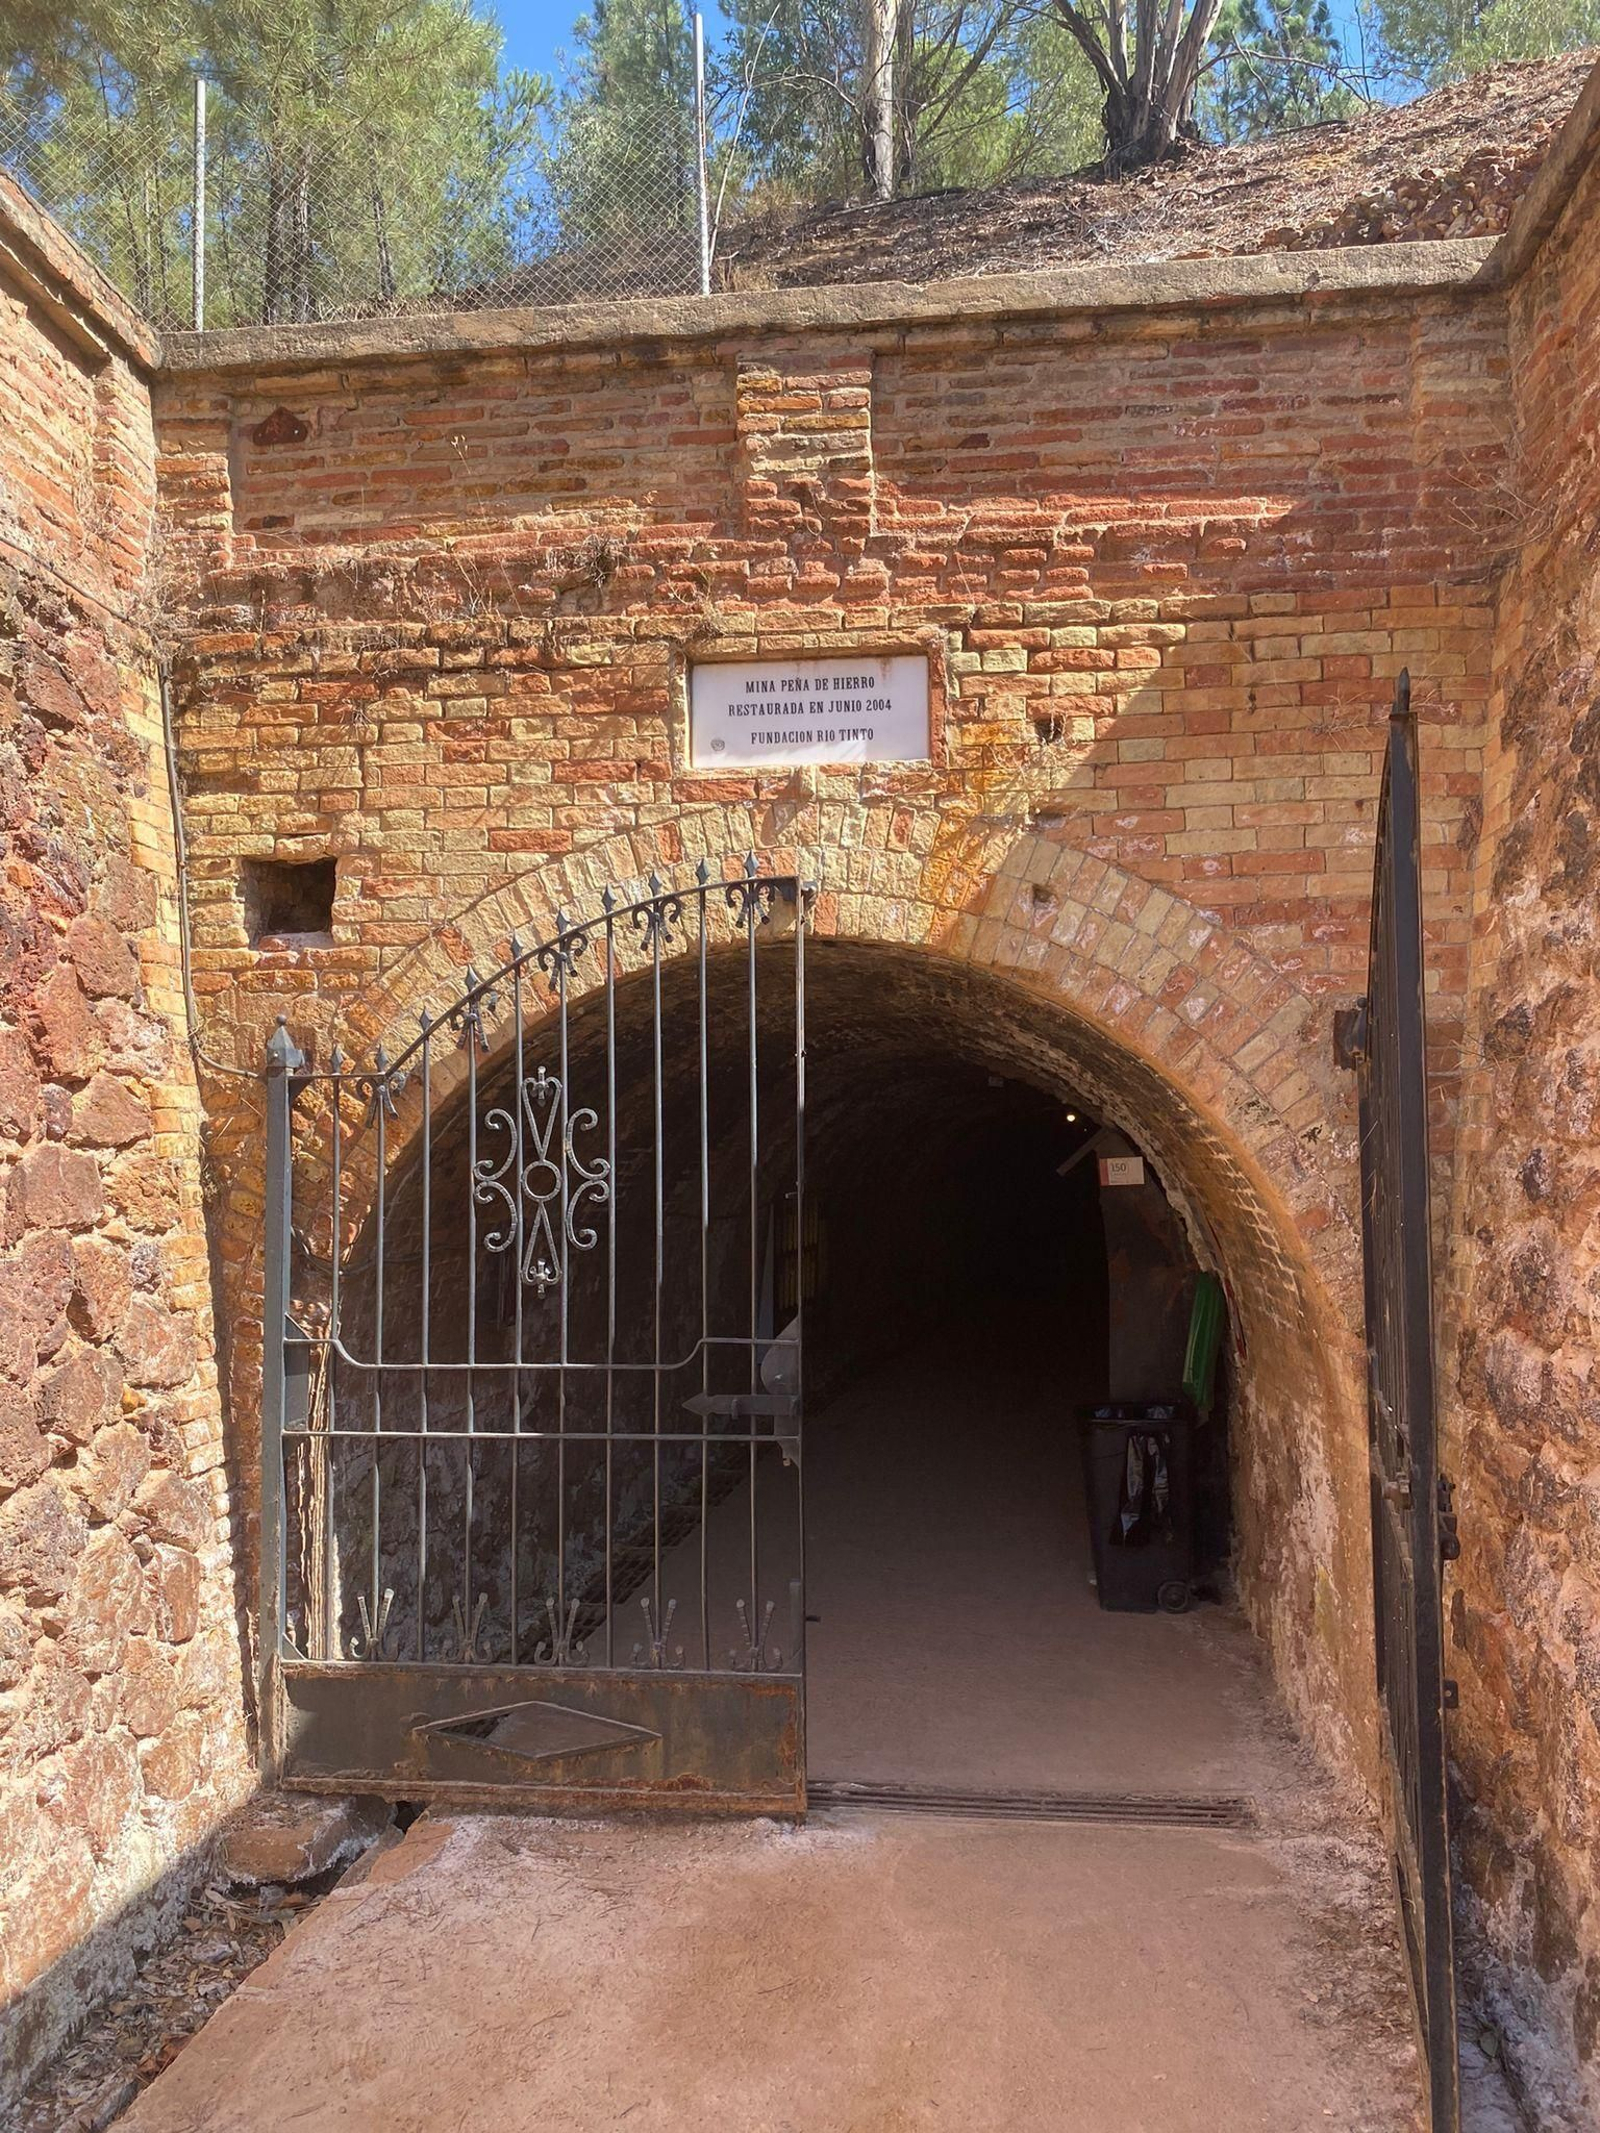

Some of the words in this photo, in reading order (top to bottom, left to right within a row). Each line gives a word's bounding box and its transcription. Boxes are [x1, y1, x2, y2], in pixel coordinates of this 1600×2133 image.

[746, 680, 776, 694] MINA
[781, 677, 810, 693] PEÑA
[815, 678, 829, 691] DE
[833, 676, 875, 690] HIERRO
[728, 702, 804, 717] RESTAURADA
[809, 701, 825, 714] EN
[828, 700, 862, 713] JUNIO
[866, 699, 892, 712] 2004
[751, 730, 813, 745] FUNDACION
[816, 729, 836, 743] RIO
[839, 728, 874, 742] TINTO
